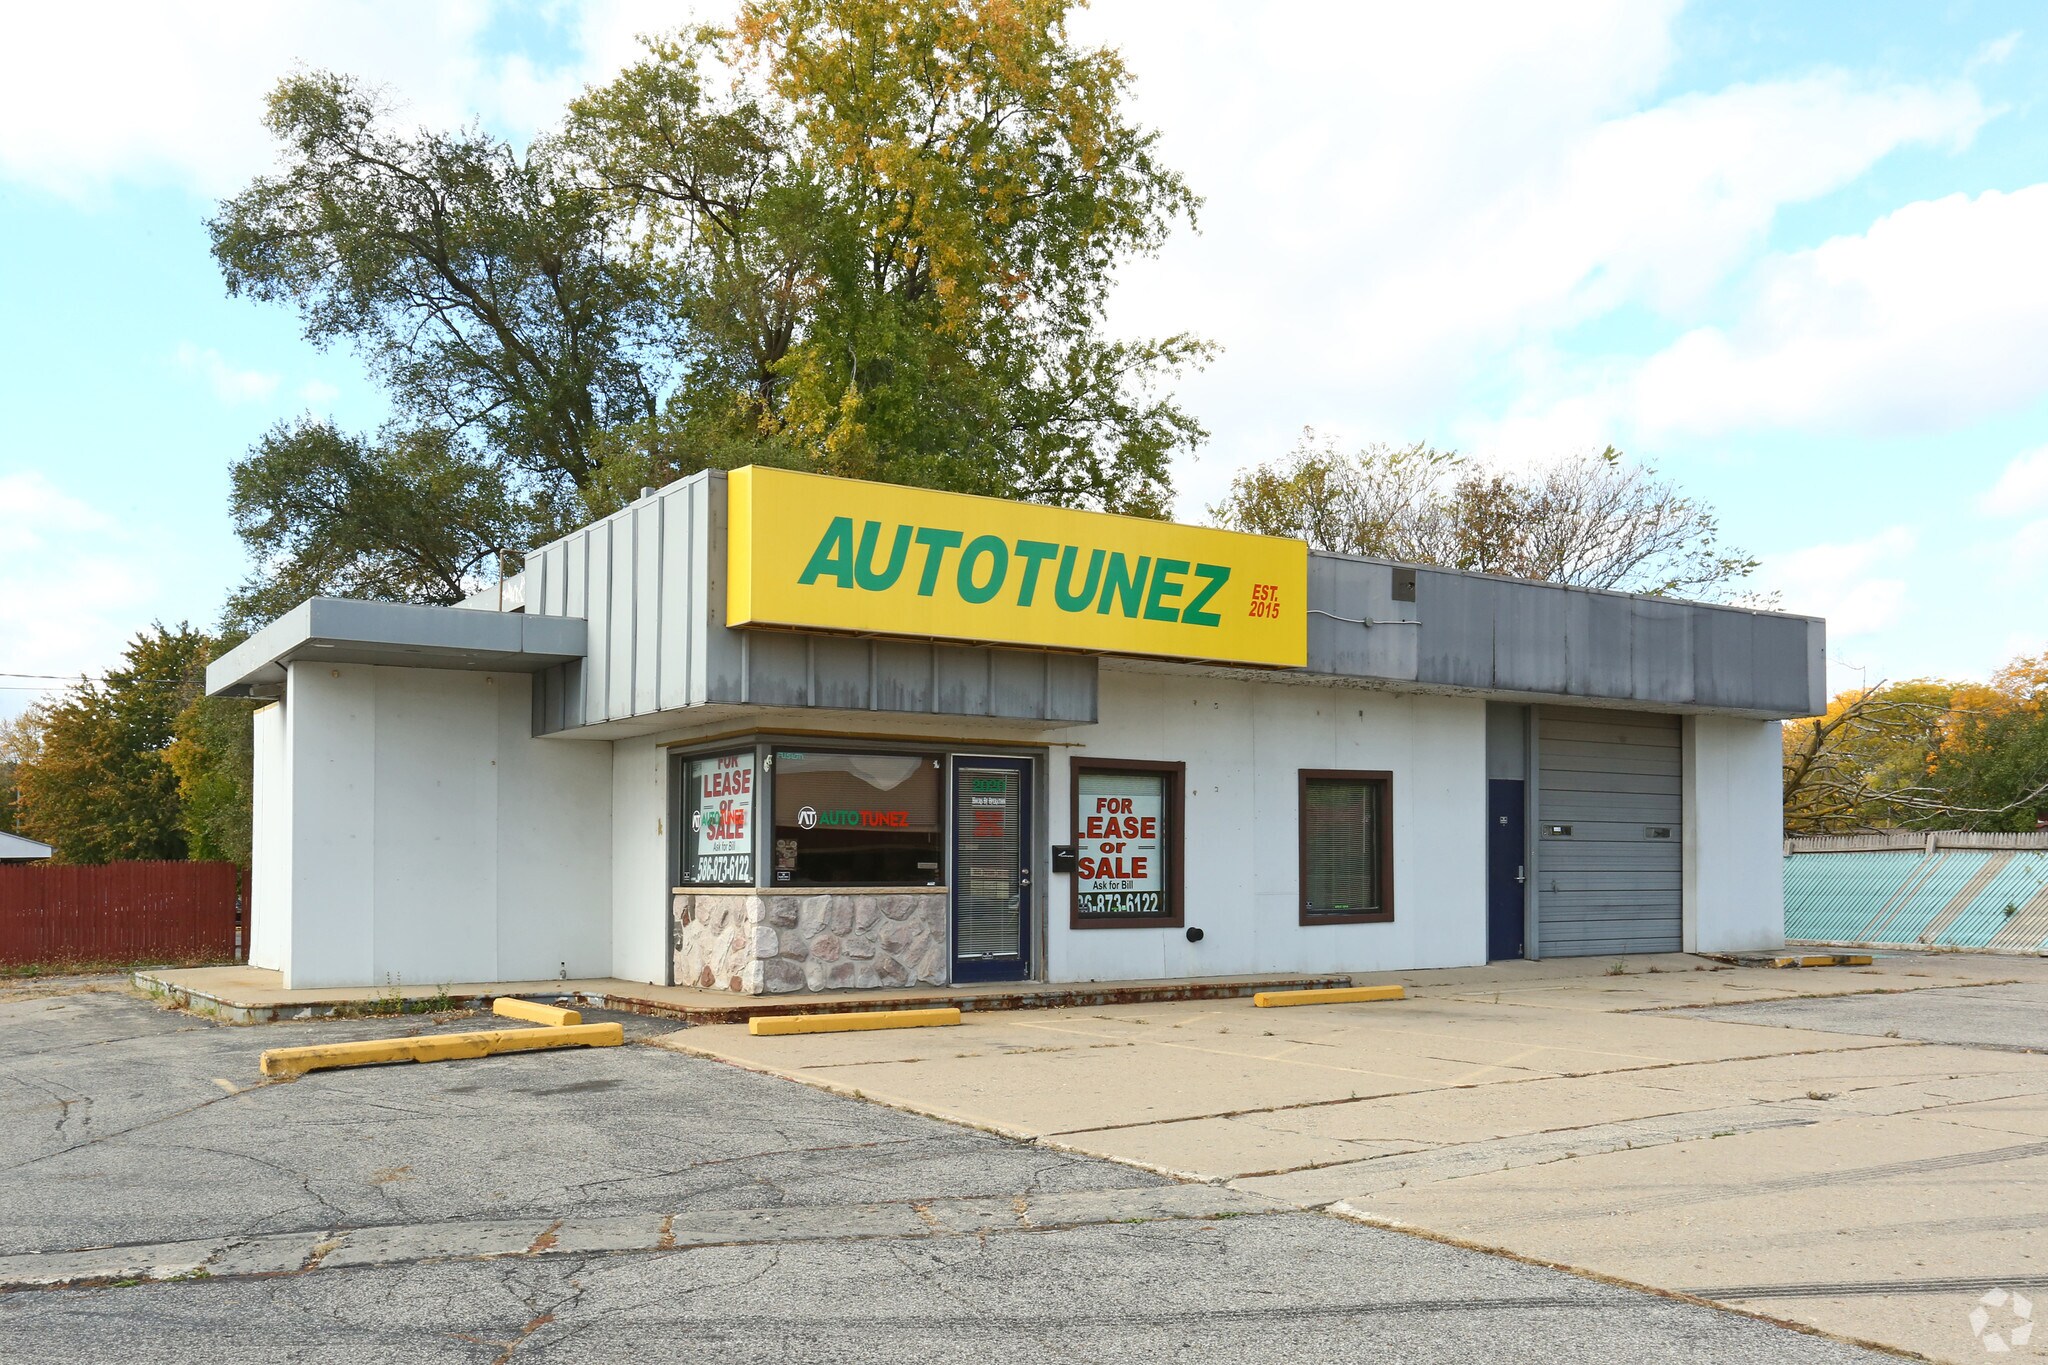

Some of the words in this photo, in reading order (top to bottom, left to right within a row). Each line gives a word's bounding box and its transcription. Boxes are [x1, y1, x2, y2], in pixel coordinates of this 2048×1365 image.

[797, 516, 1231, 628] AUTOTUNEZ
[1252, 584, 1278, 602] EST.
[1248, 601, 1280, 619] 2015
[703, 768, 752, 798] LEASE
[1096, 797, 1133, 814] FOR
[706, 815, 745, 841] SALE
[713, 842, 721, 851] Ask
[721, 842, 729, 851] for
[1099, 842, 1127, 854] or
[697, 855, 750, 881] 586-873-6122
[1078, 857, 1148, 880] SALE
[1092, 881, 1107, 890] Ask
[1109, 881, 1120, 890] for
[1121, 880, 1134, 890] Bill
